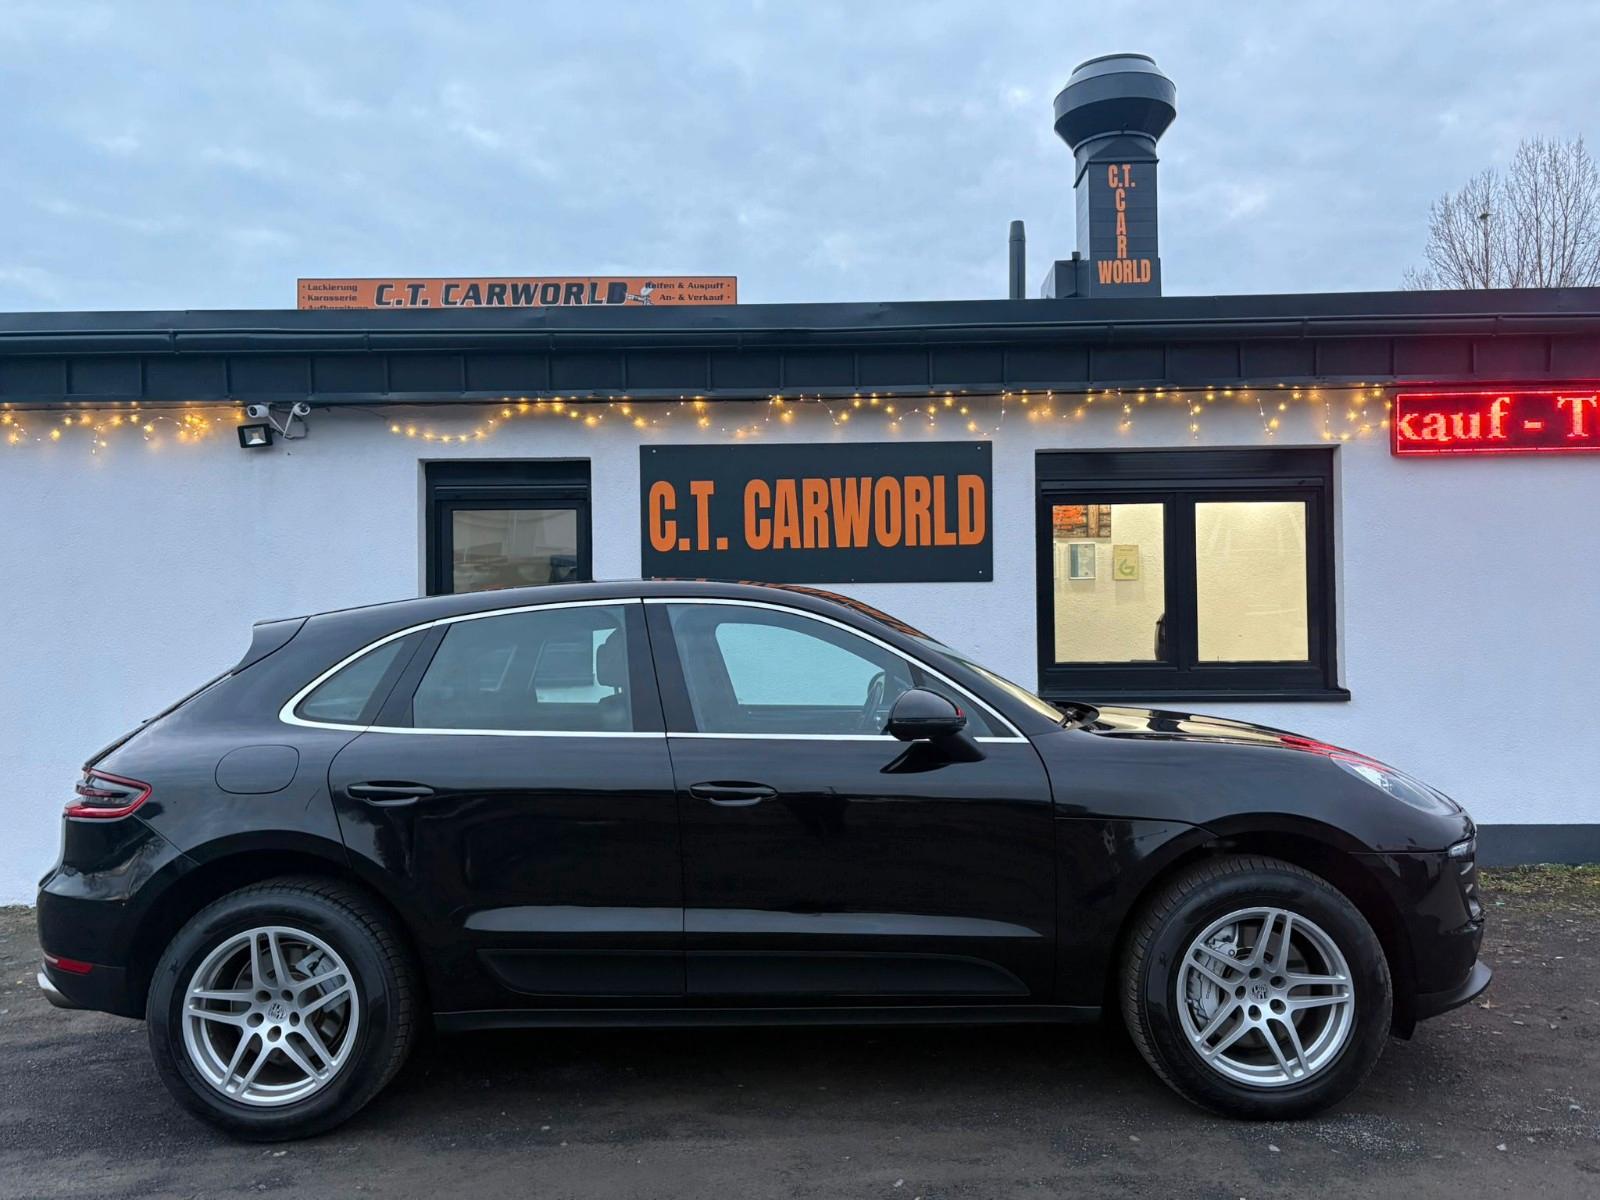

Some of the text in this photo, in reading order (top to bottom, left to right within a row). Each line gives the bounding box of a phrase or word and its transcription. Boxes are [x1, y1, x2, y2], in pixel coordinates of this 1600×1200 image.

[1108, 164, 1136, 188] C.T.
[1098, 259, 1151, 284] WORLD
[307, 283, 358, 292] Lackierung
[375, 281, 628, 306] C.T. CARWORLD
[688, 282, 724, 290] Auspuff
[648, 475, 986, 552] C.T. CARWORLD
